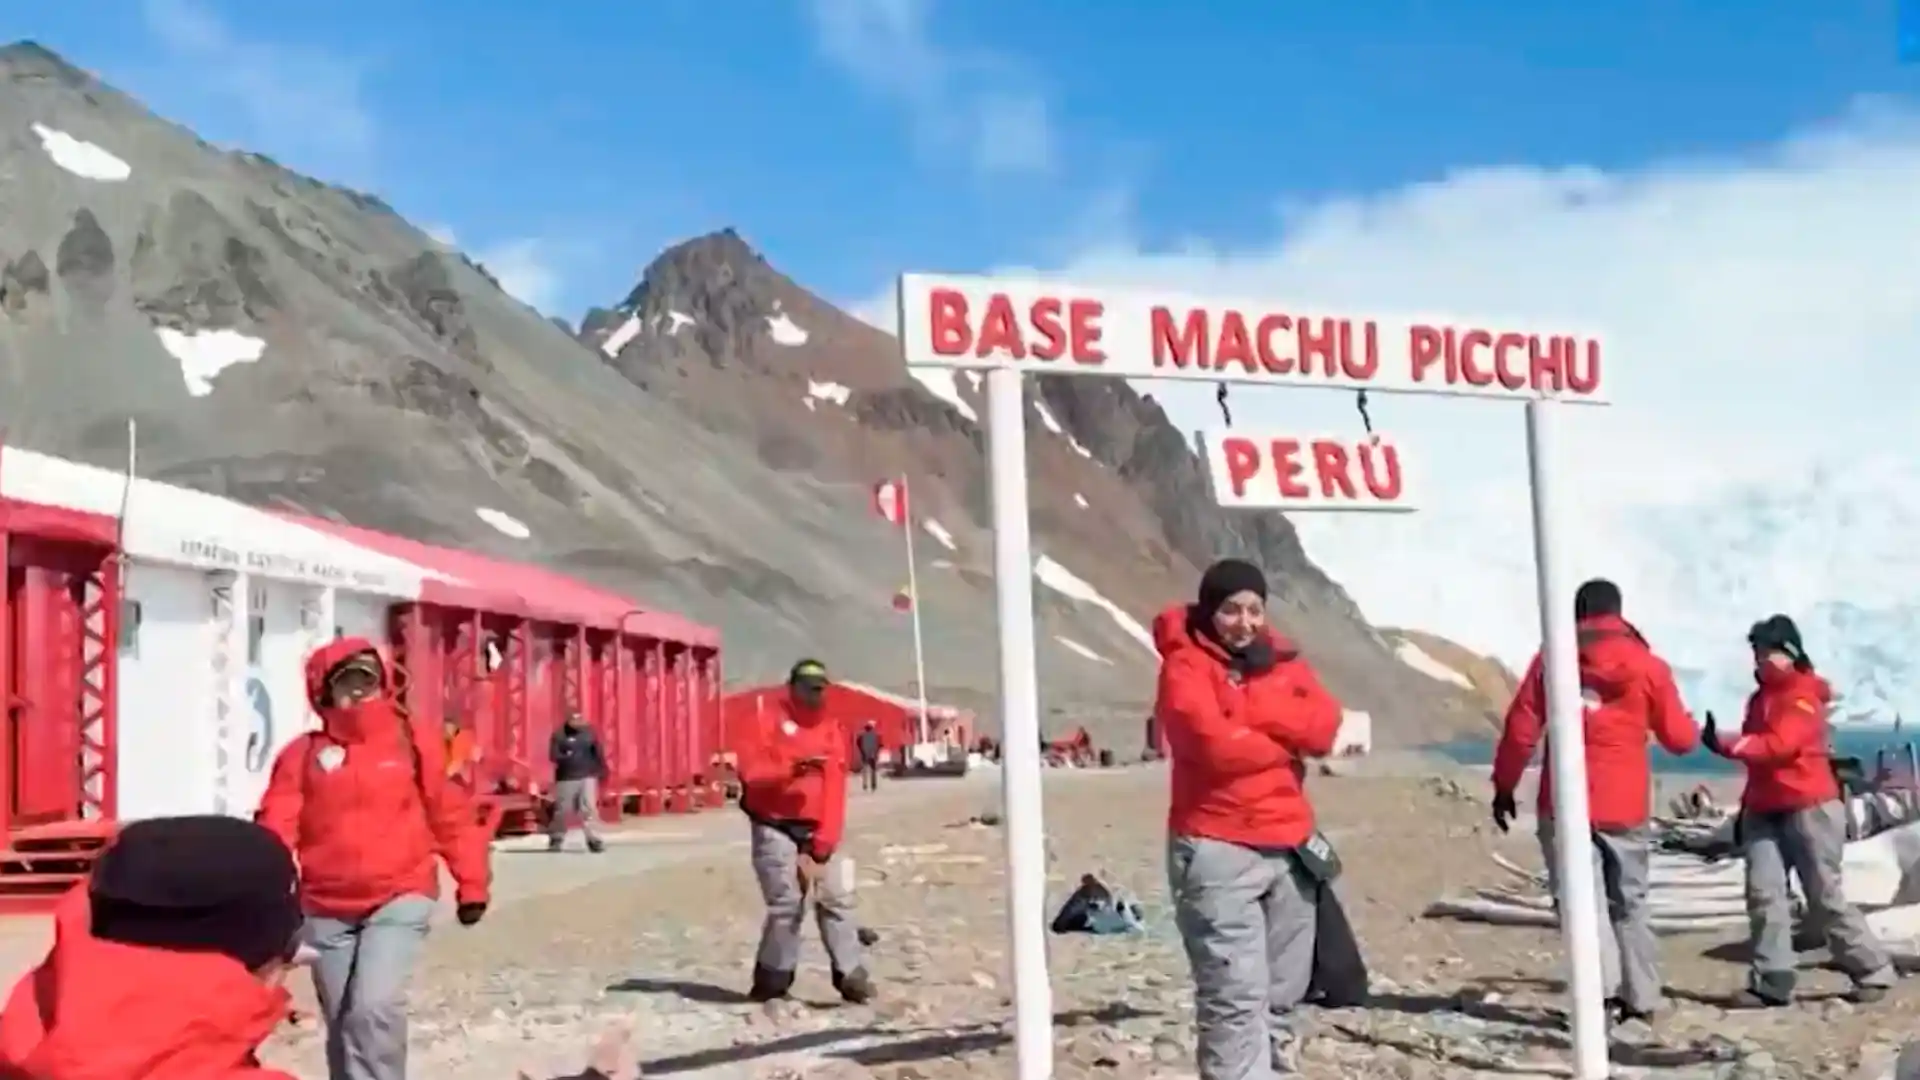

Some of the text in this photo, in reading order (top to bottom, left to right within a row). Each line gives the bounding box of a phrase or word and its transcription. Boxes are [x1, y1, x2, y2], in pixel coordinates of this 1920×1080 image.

[929, 289, 1600, 393] BASE MACHU PICCHU
[1225, 432, 1401, 500] PERÚ
